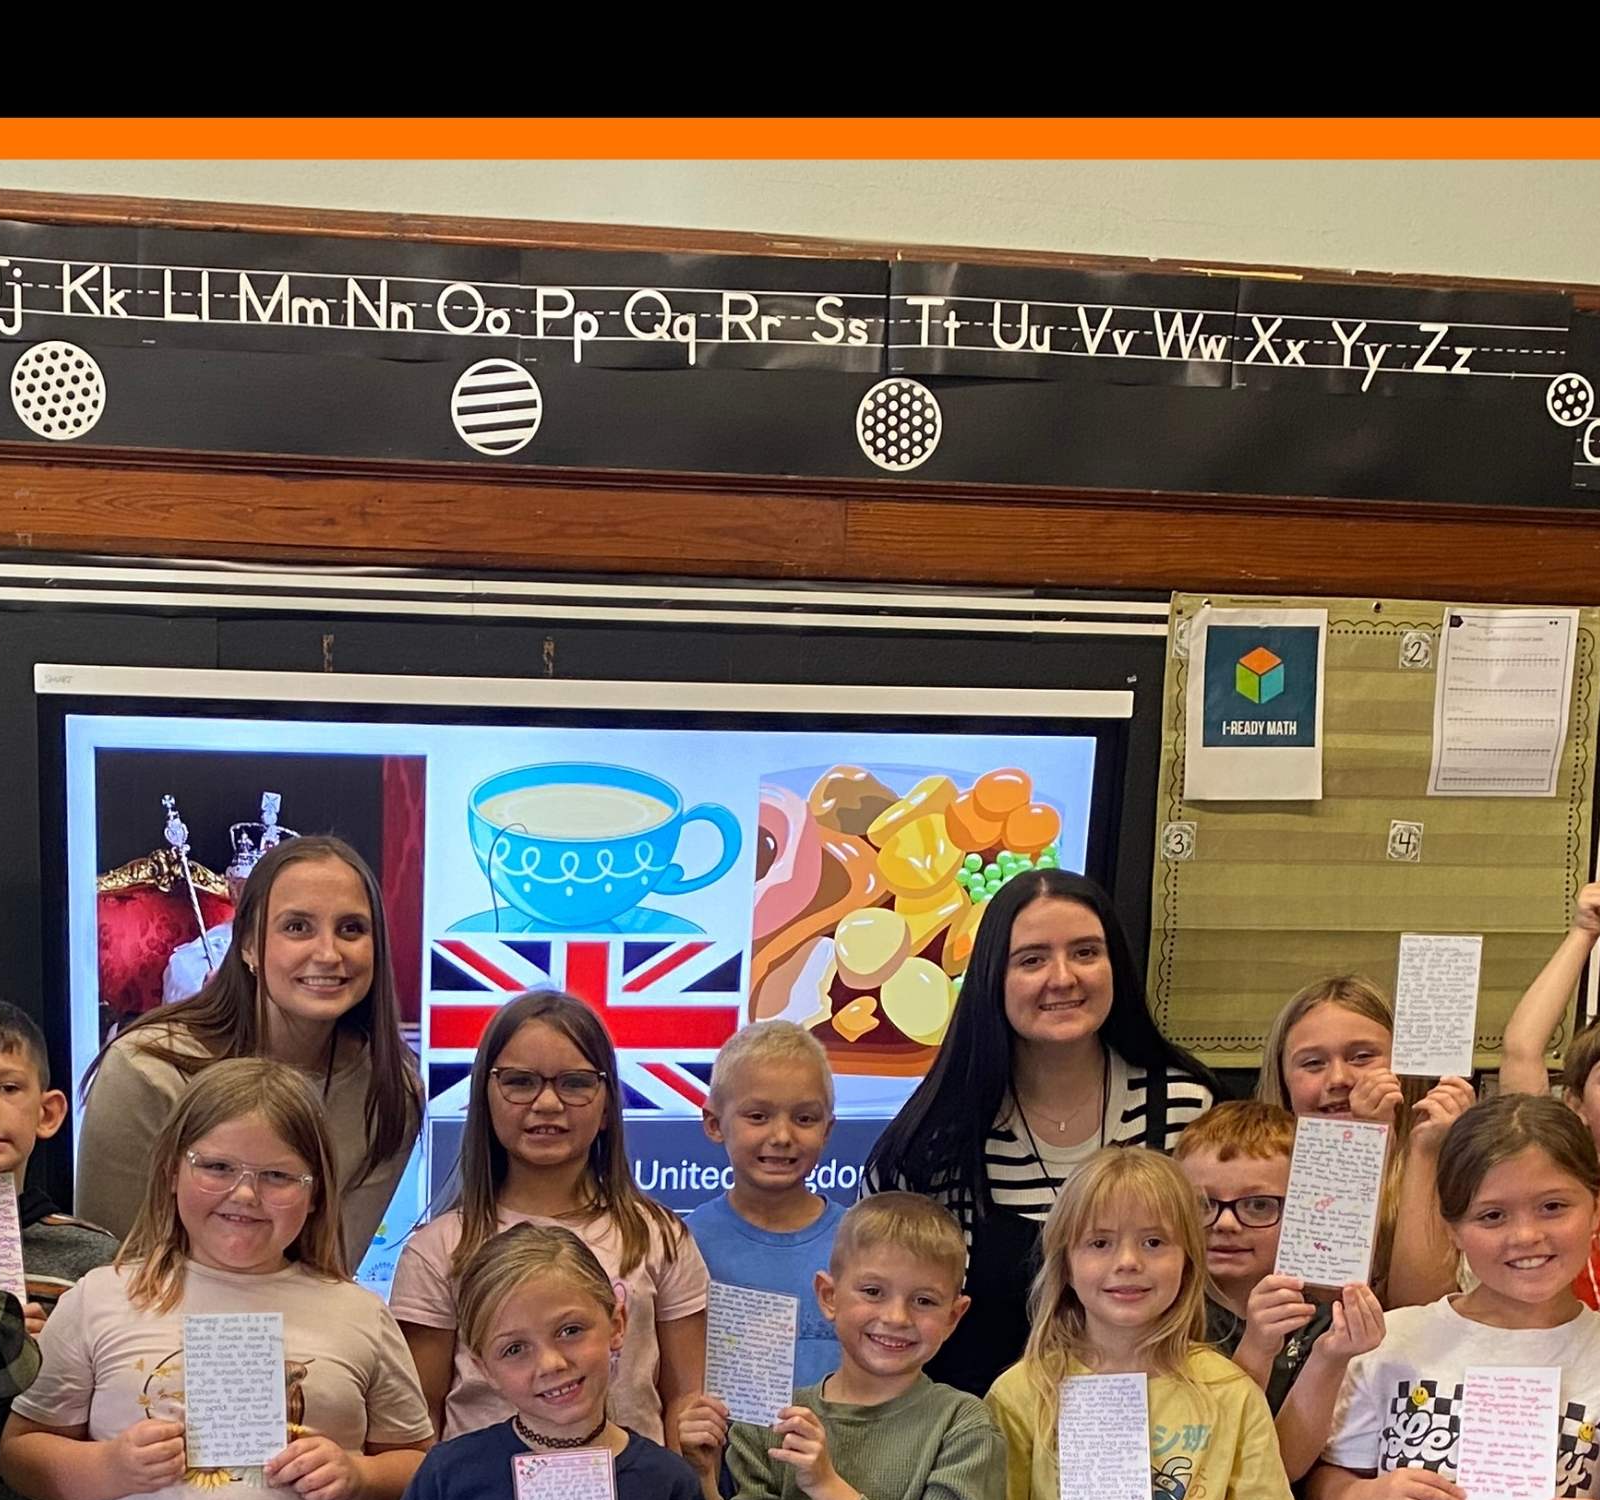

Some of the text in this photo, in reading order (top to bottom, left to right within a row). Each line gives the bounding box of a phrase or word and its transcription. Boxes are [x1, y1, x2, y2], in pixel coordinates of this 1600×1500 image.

[62, 262, 129, 319] Kk
[164, 269, 209, 322] Ll
[239, 274, 329, 327] Mm
[346, 279, 414, 331] Nn
[437, 284, 510, 335] Oo
[536, 288, 599, 363] Pp
[624, 288, 697, 365] Qq
[721, 292, 781, 341] Rr
[812, 296, 868, 345] Ss
[906, 297, 960, 348] Tt
[993, 302, 1050, 352] Uu
[1077, 306, 1135, 356] Vv
[1153, 310, 1227, 361] Ww
[1245, 316, 1305, 365] Xx
[1332, 320, 1387, 392] Yy
[1413, 323, 1473, 374] Zz
[1409, 642, 1422, 662] 2
[1222, 721, 1297, 735] I-READY MATH
[1173, 833, 1185, 854] 3
[1400, 833, 1413, 854] 4
